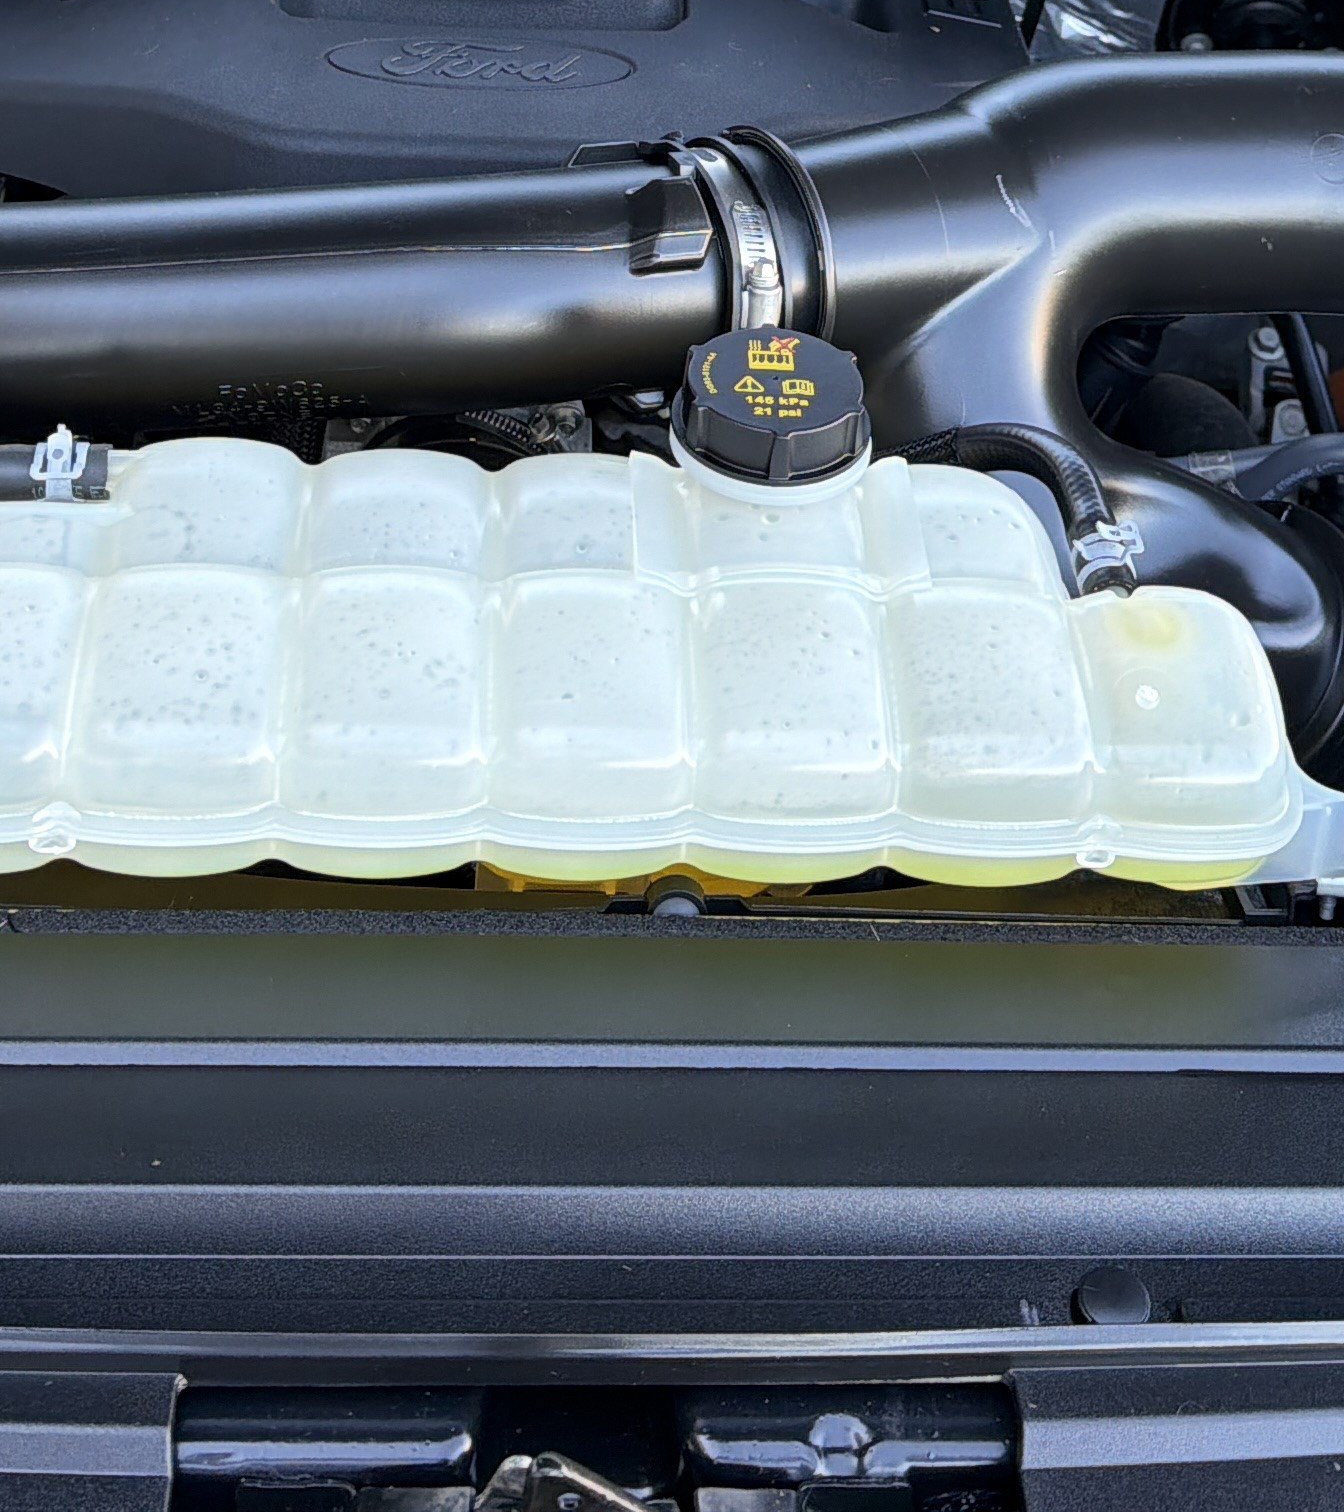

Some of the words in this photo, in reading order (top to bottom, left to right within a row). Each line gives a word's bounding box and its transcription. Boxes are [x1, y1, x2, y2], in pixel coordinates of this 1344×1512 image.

[380, 40, 583, 84] Ford
[778, 396, 809, 407] kPa
[753, 406, 772, 416] 21
[778, 408, 802, 418] psi
